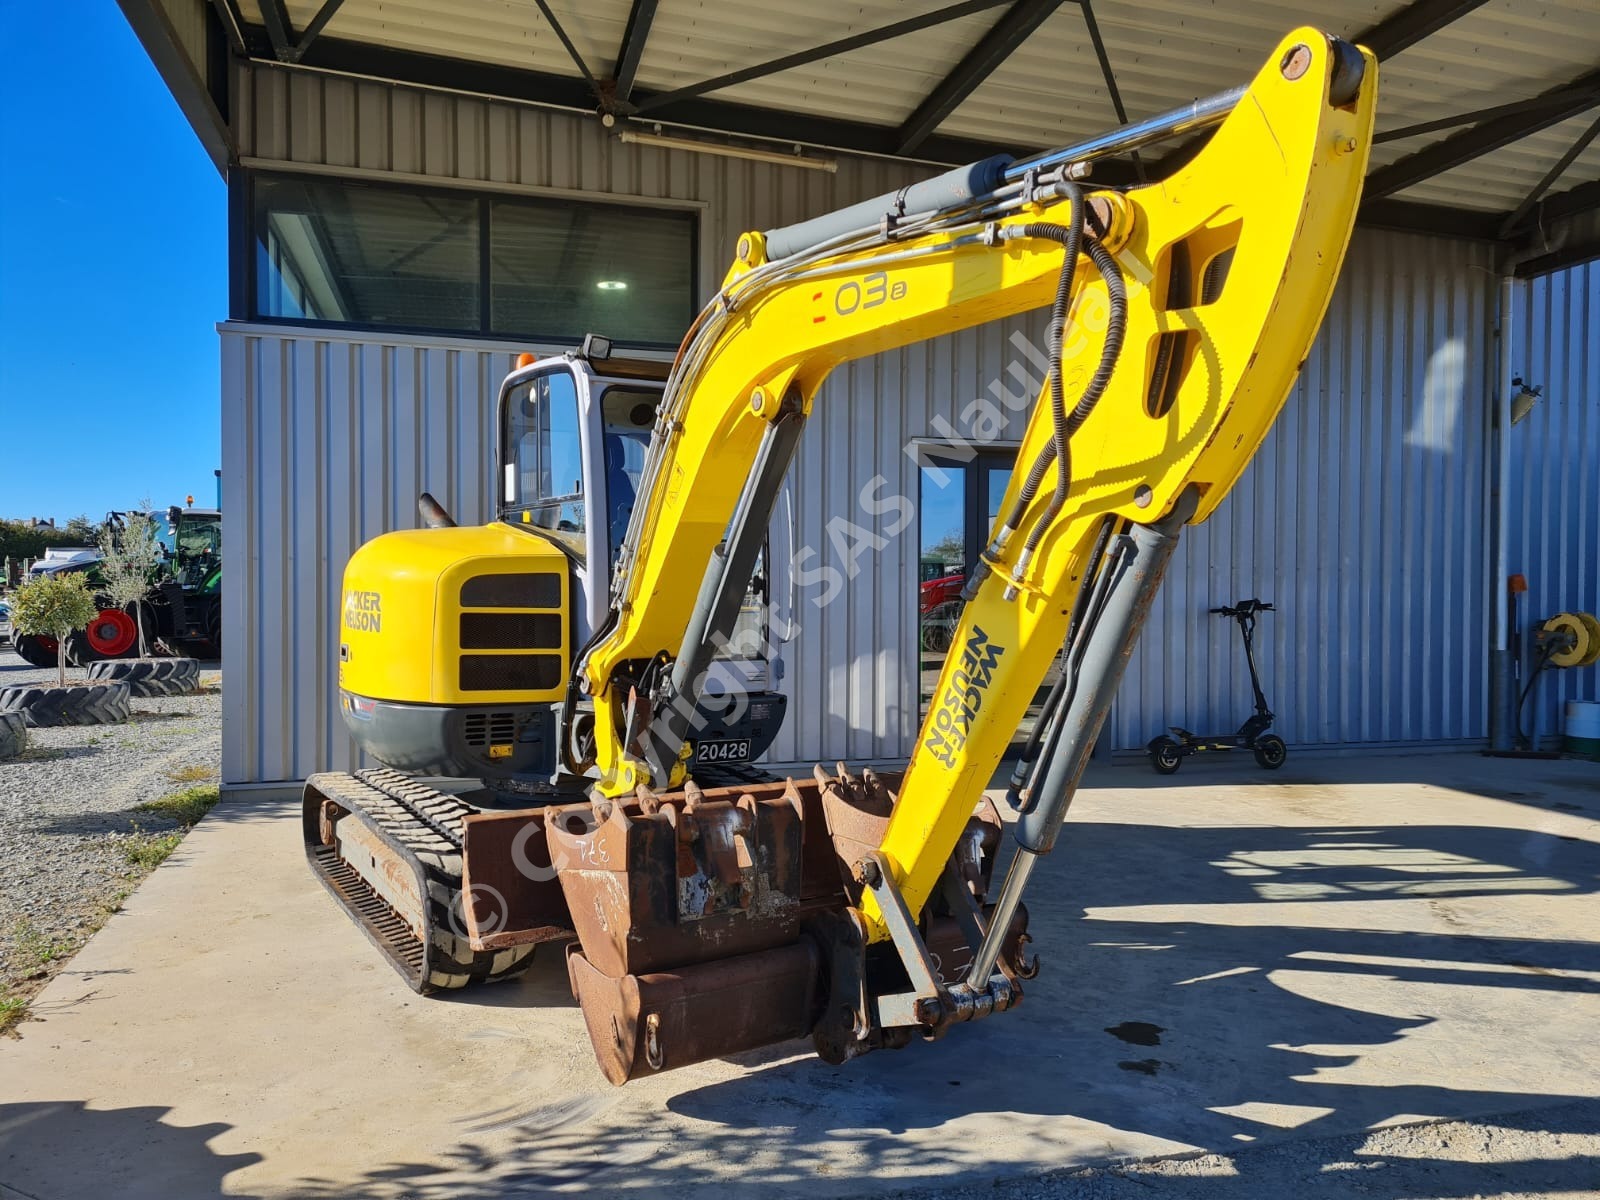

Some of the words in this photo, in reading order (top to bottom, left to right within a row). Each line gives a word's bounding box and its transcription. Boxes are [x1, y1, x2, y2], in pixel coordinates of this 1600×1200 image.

[698, 742, 749, 761] 20428
[925, 624, 989, 758] NEUSON
[938, 643, 1004, 769] WACKER
